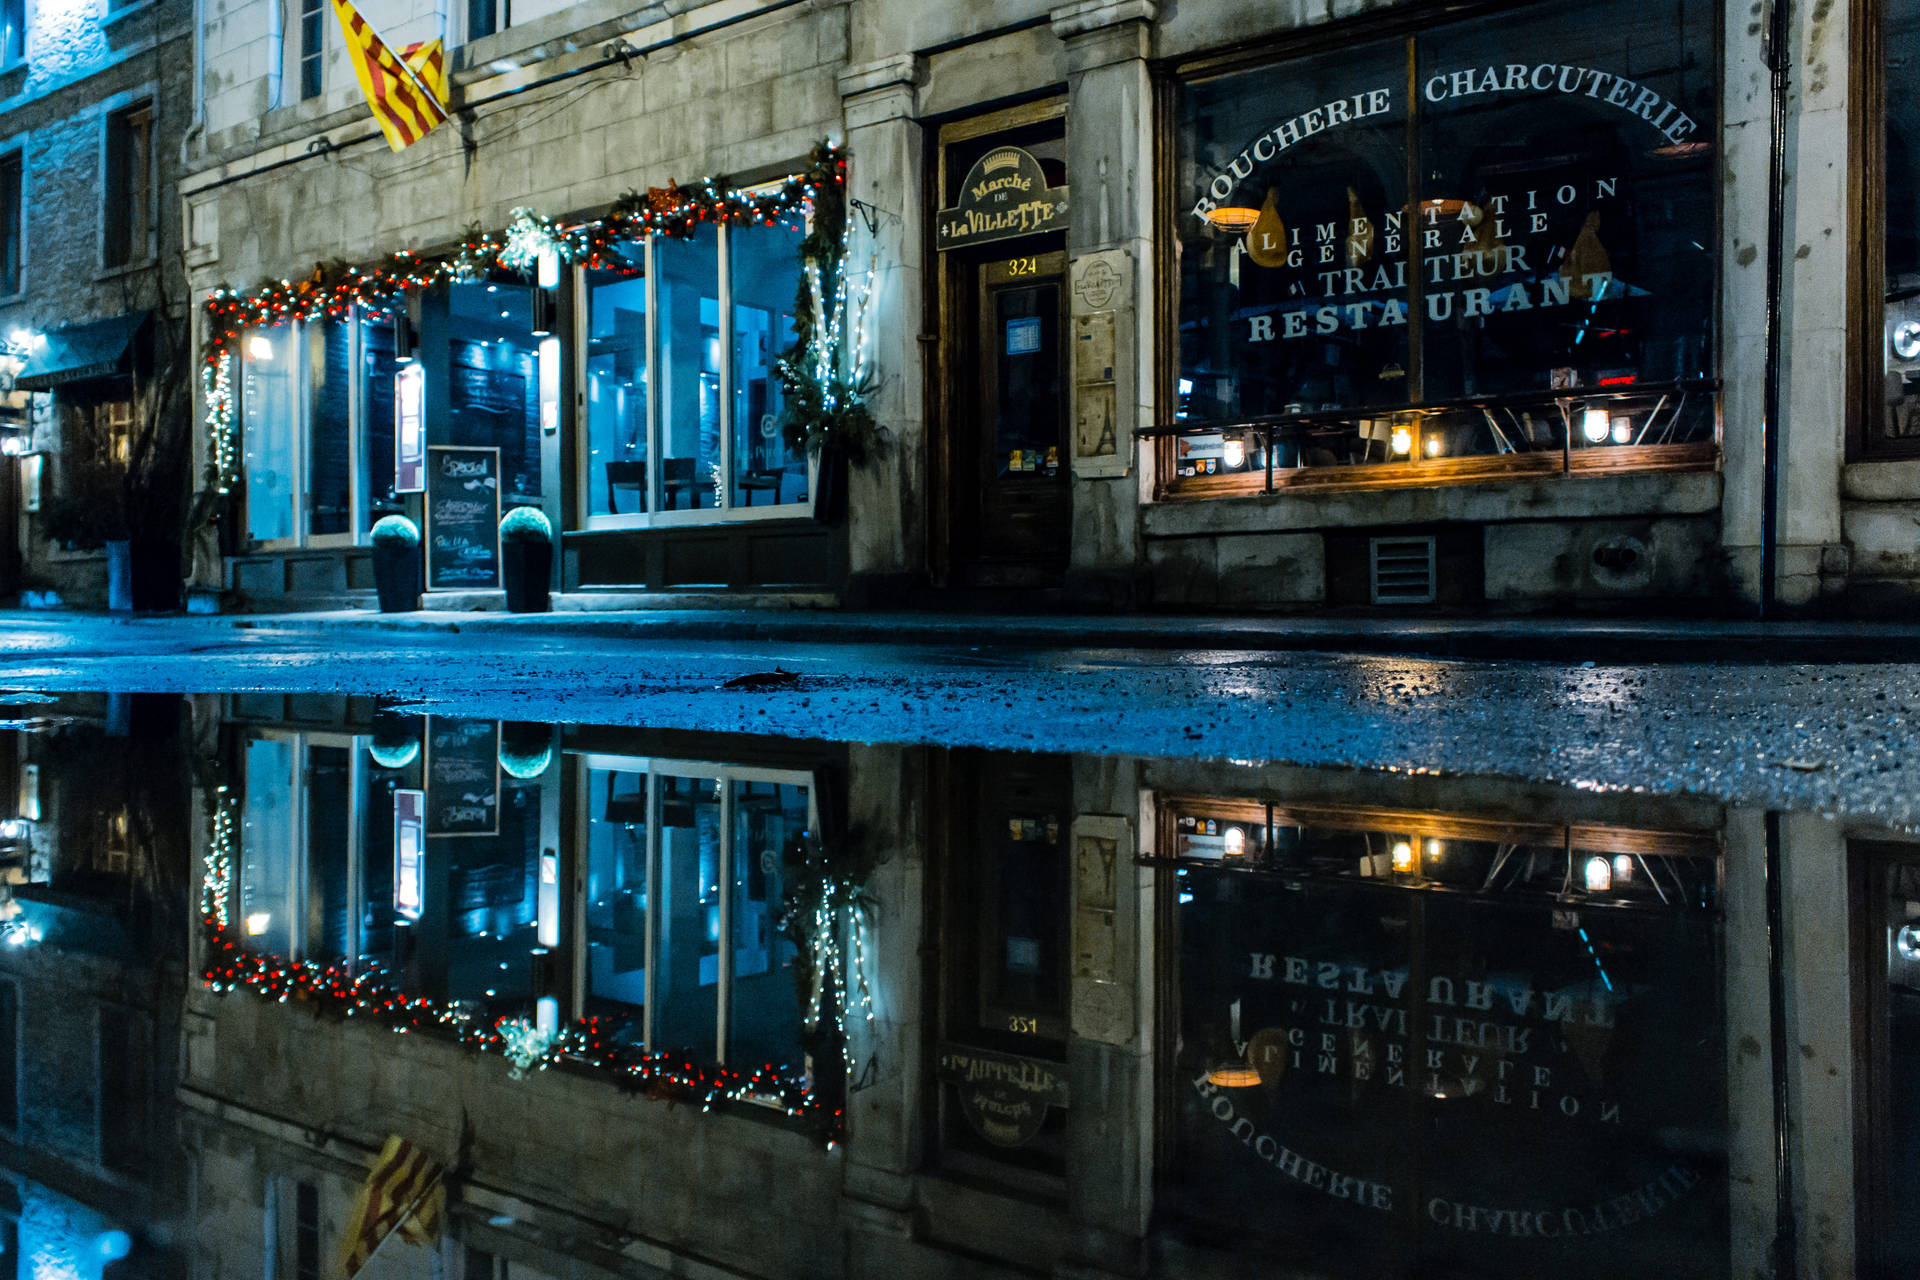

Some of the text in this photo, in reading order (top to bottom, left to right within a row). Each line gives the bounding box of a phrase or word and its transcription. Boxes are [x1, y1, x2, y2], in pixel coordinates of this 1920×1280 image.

[1190, 63, 1698, 226] BOUCHERIE CHARCUTERIE
[971, 173, 1031, 202] Marché
[950, 221, 969, 238] La
[1234, 177, 1618, 255] ALIMENTATION
[1287, 212, 1549, 268] GÉNÉRALE
[1008, 257, 1037, 276] 324
[1317, 244, 1534, 298] TRAITEUR
[1248, 271, 1613, 342] RESTAURANT
